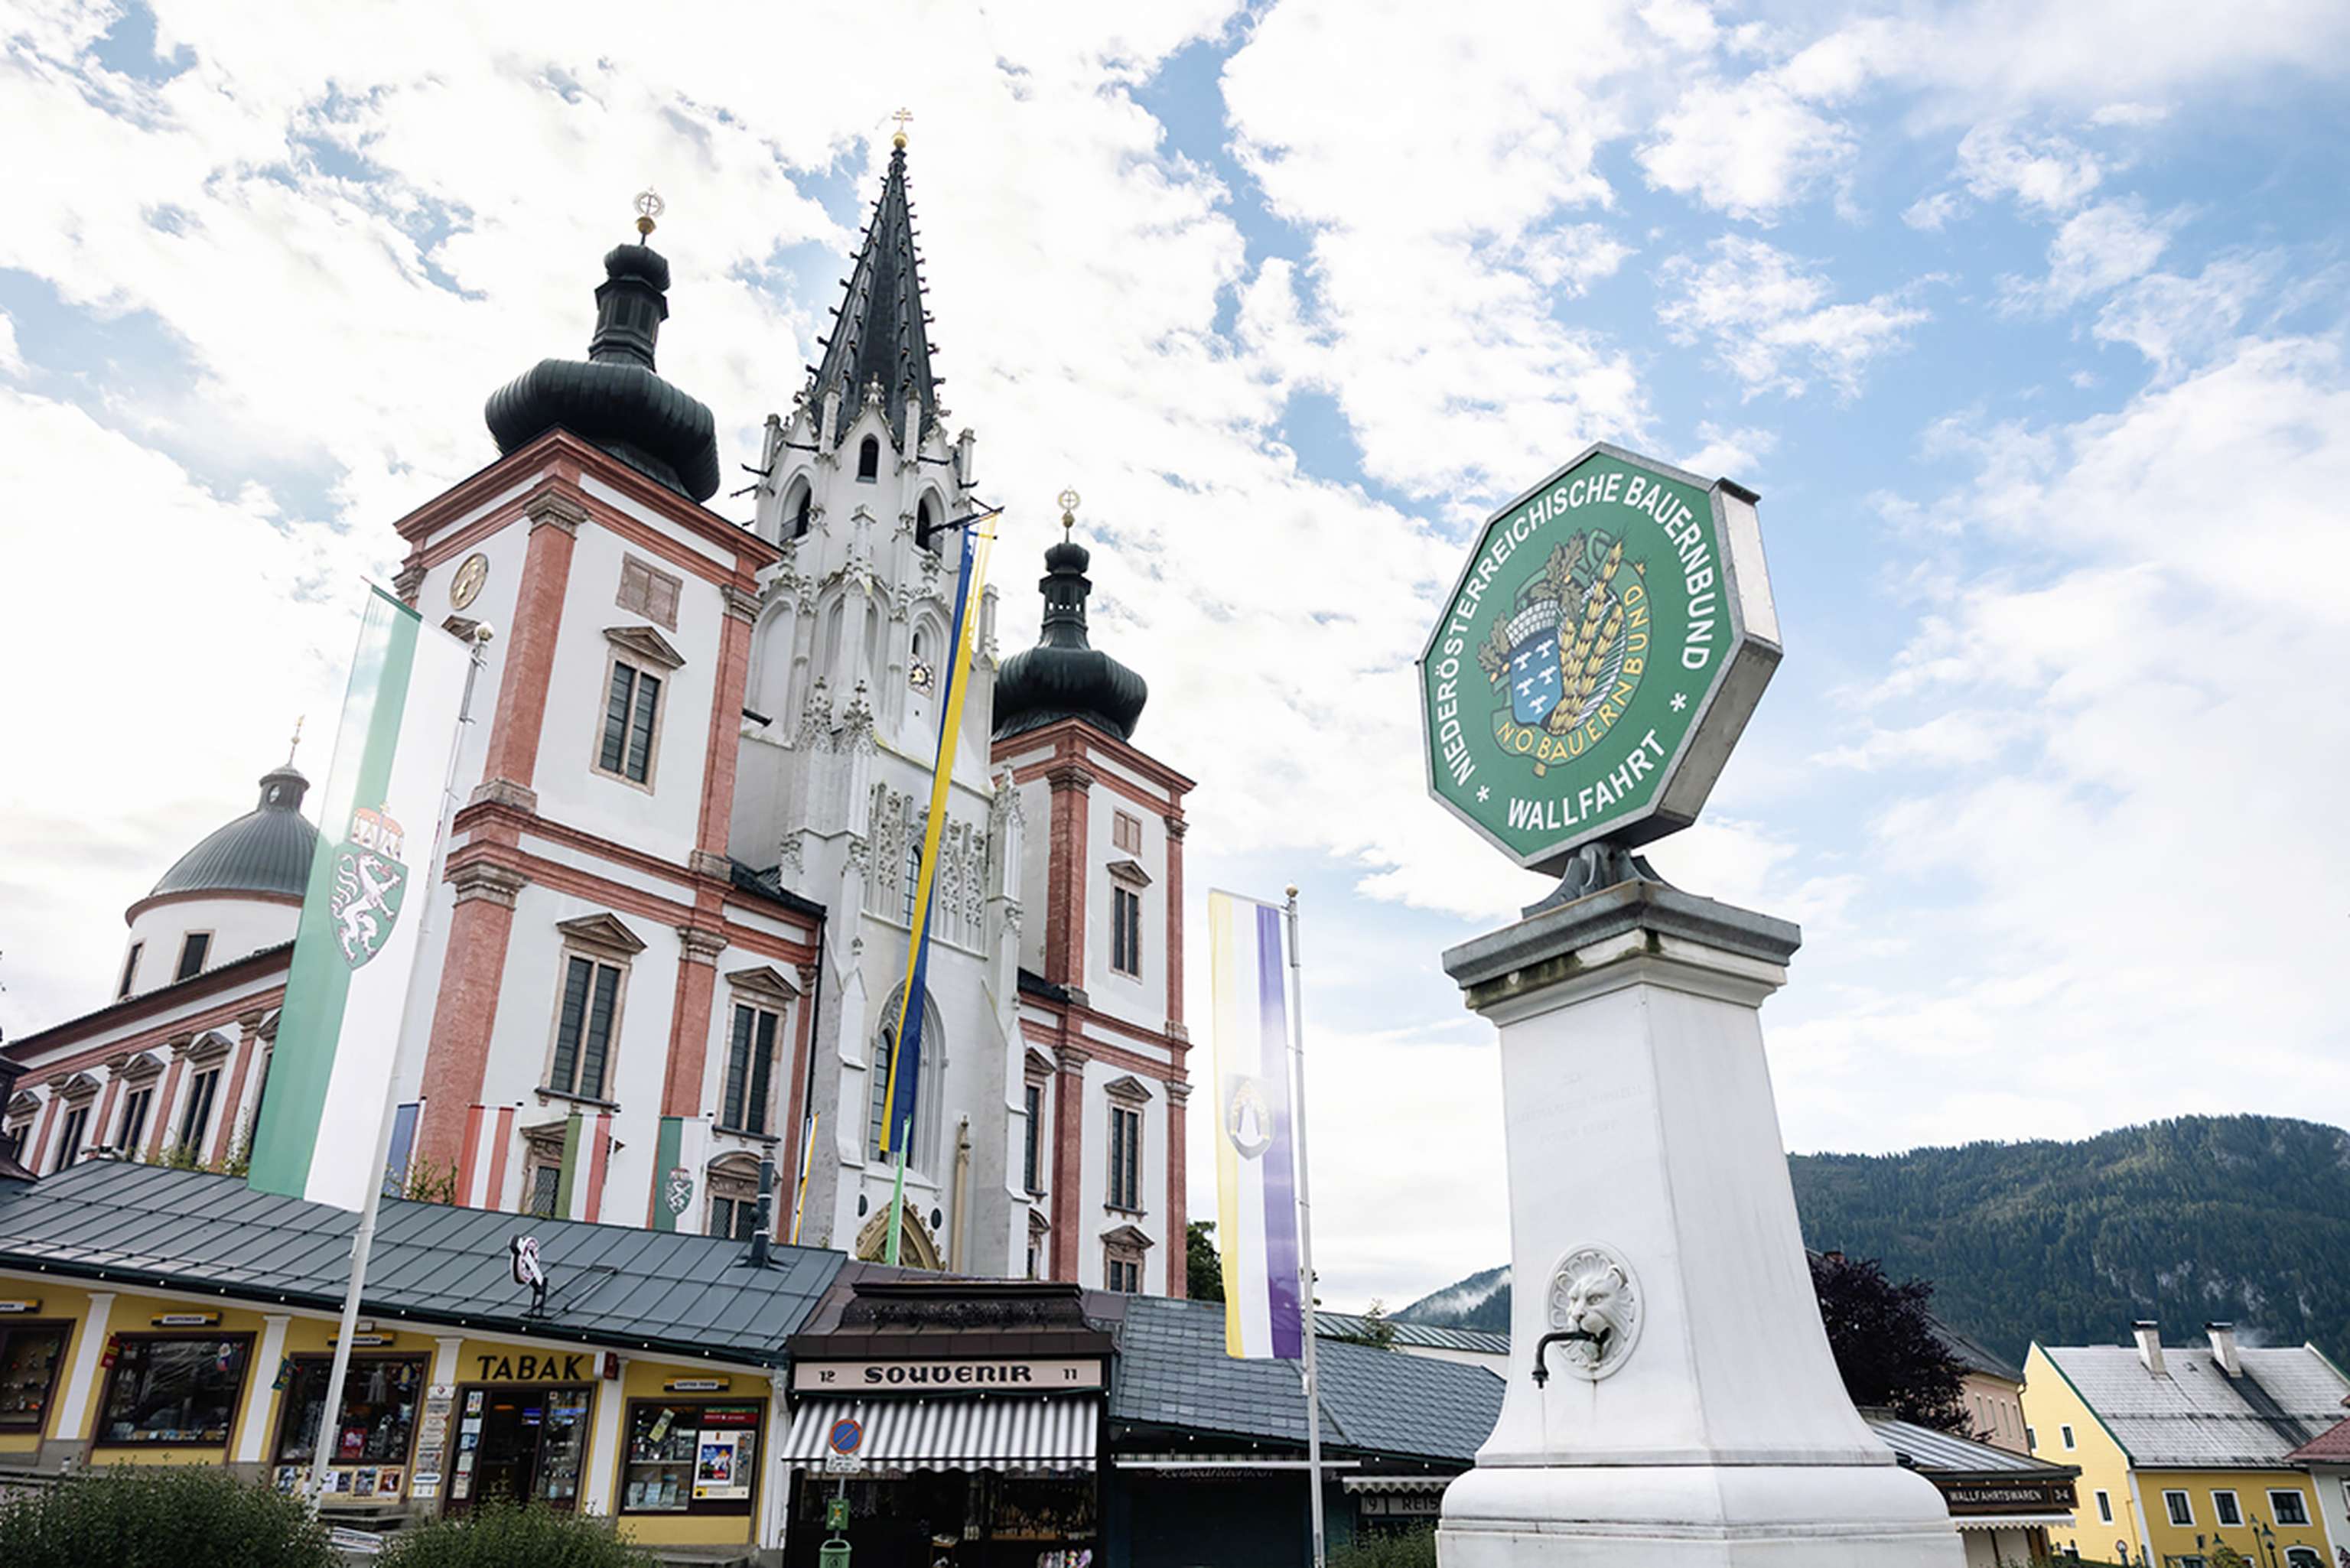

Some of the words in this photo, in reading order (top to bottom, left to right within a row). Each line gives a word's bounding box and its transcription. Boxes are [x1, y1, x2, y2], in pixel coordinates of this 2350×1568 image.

[1435, 473, 1623, 786] NIEDERÖSTERREICHISCHE
[1623, 475, 1716, 670] BAUERNBUND
[1508, 728, 1665, 831] WALLFAHRT
[477, 1355, 584, 1381] TABAK
[819, 1370, 835, 1383] 12
[864, 1365, 1033, 1384] SOUVENIR
[1063, 1368, 1078, 1380] 11
